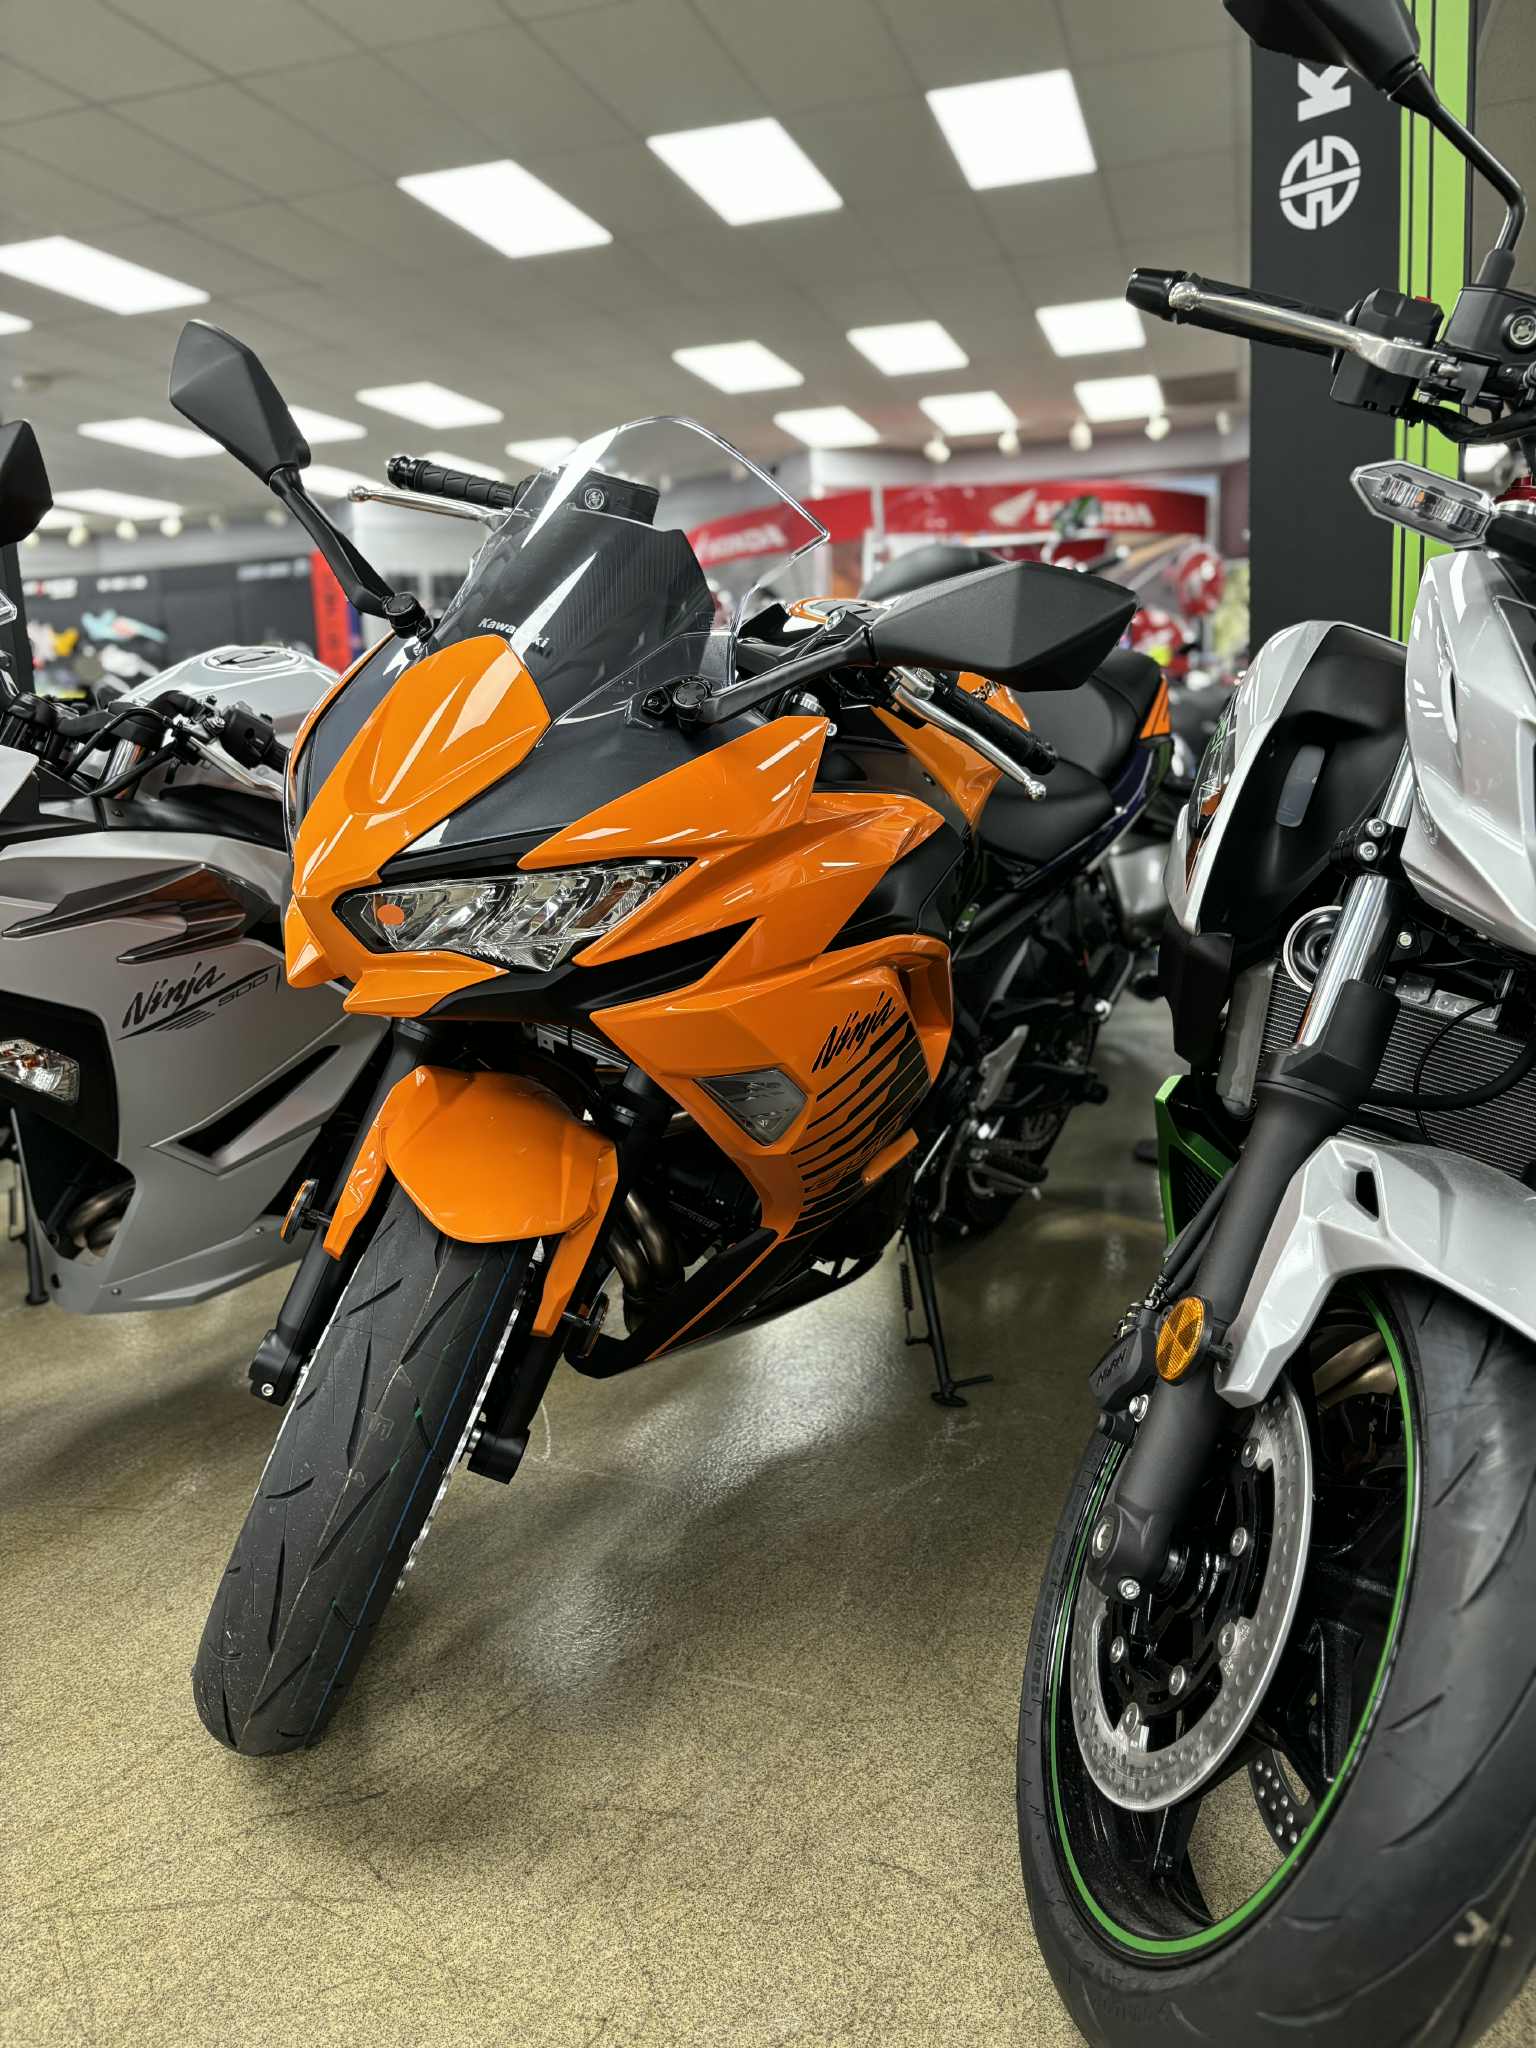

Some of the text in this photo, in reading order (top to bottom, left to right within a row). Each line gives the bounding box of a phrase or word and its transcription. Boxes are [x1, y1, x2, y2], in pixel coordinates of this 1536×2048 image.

[477, 617, 550, 648] Kawaki
[122, 961, 226, 1029] Ninja
[811, 991, 896, 1073] Ninja
